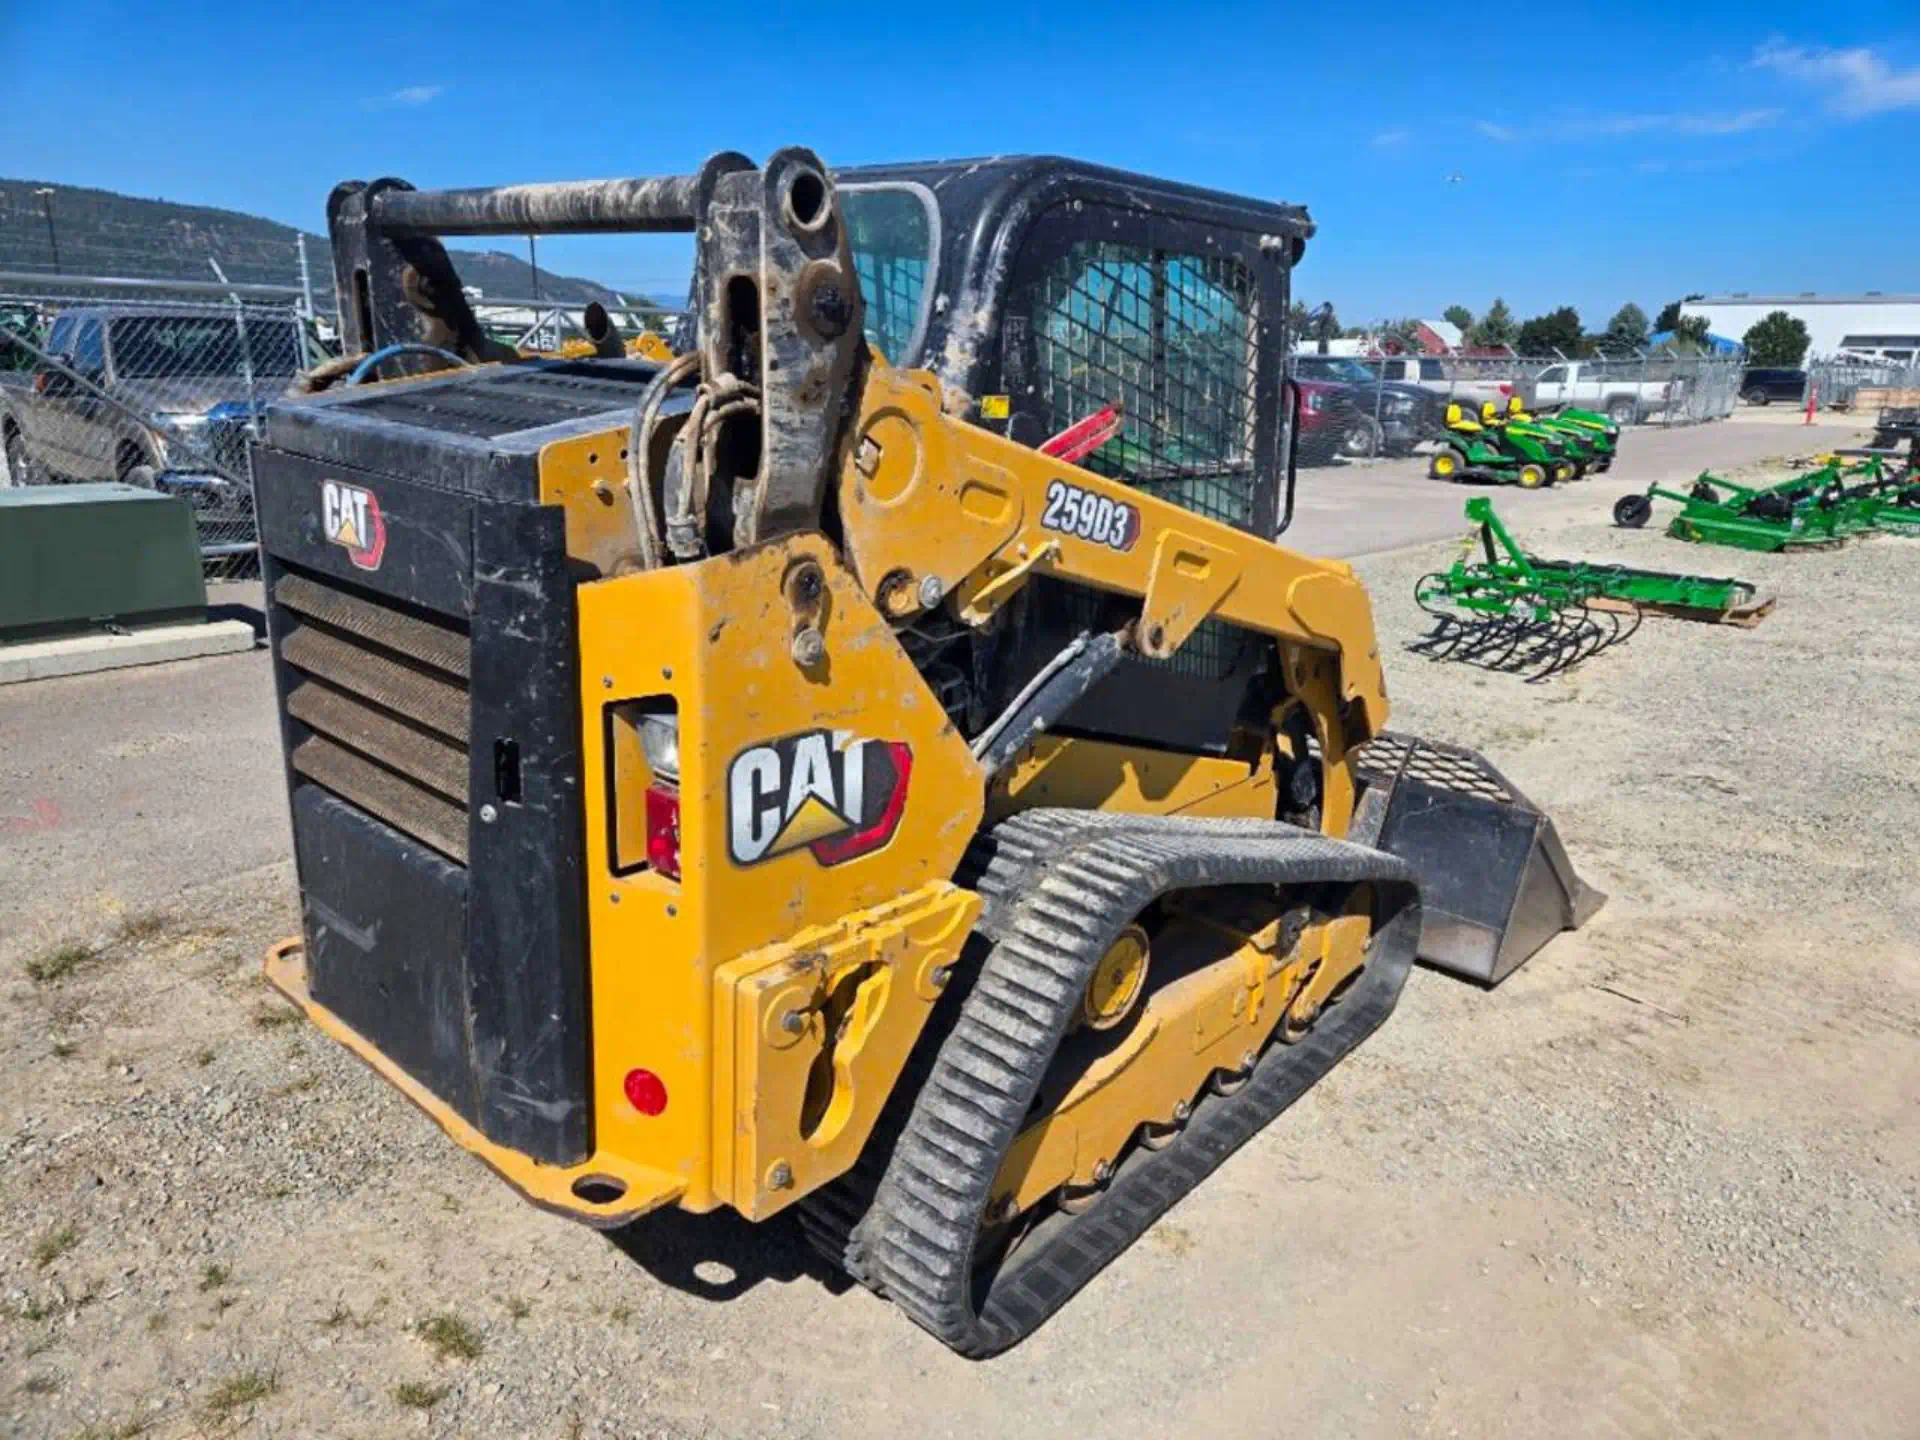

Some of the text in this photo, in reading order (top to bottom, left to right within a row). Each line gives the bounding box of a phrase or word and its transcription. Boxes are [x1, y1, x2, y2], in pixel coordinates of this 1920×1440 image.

[322, 482, 368, 549] CAT
[1042, 481, 1129, 547] 259D3
[730, 730, 865, 863] CAT
